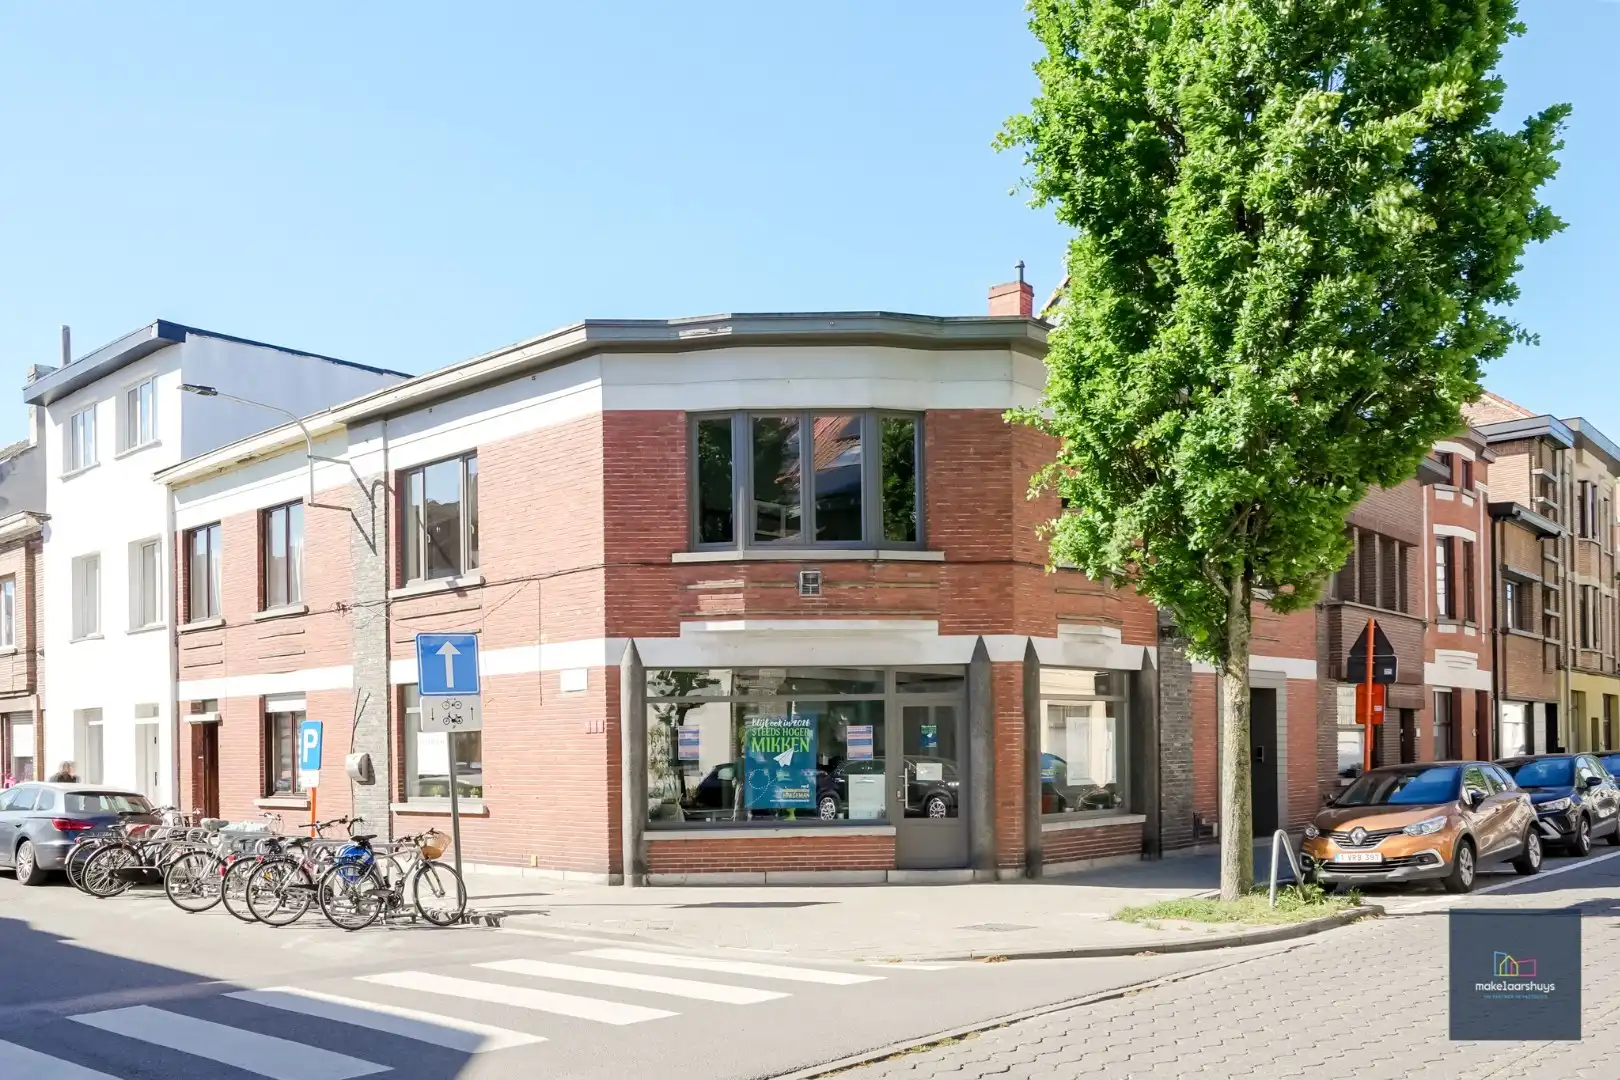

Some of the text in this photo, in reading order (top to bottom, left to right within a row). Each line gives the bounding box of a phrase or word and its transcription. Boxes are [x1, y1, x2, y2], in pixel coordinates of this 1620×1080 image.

[752, 728, 780, 736] STEEDS
[303, 728, 318, 763] P
[752, 737, 809, 752] MIKKEN
